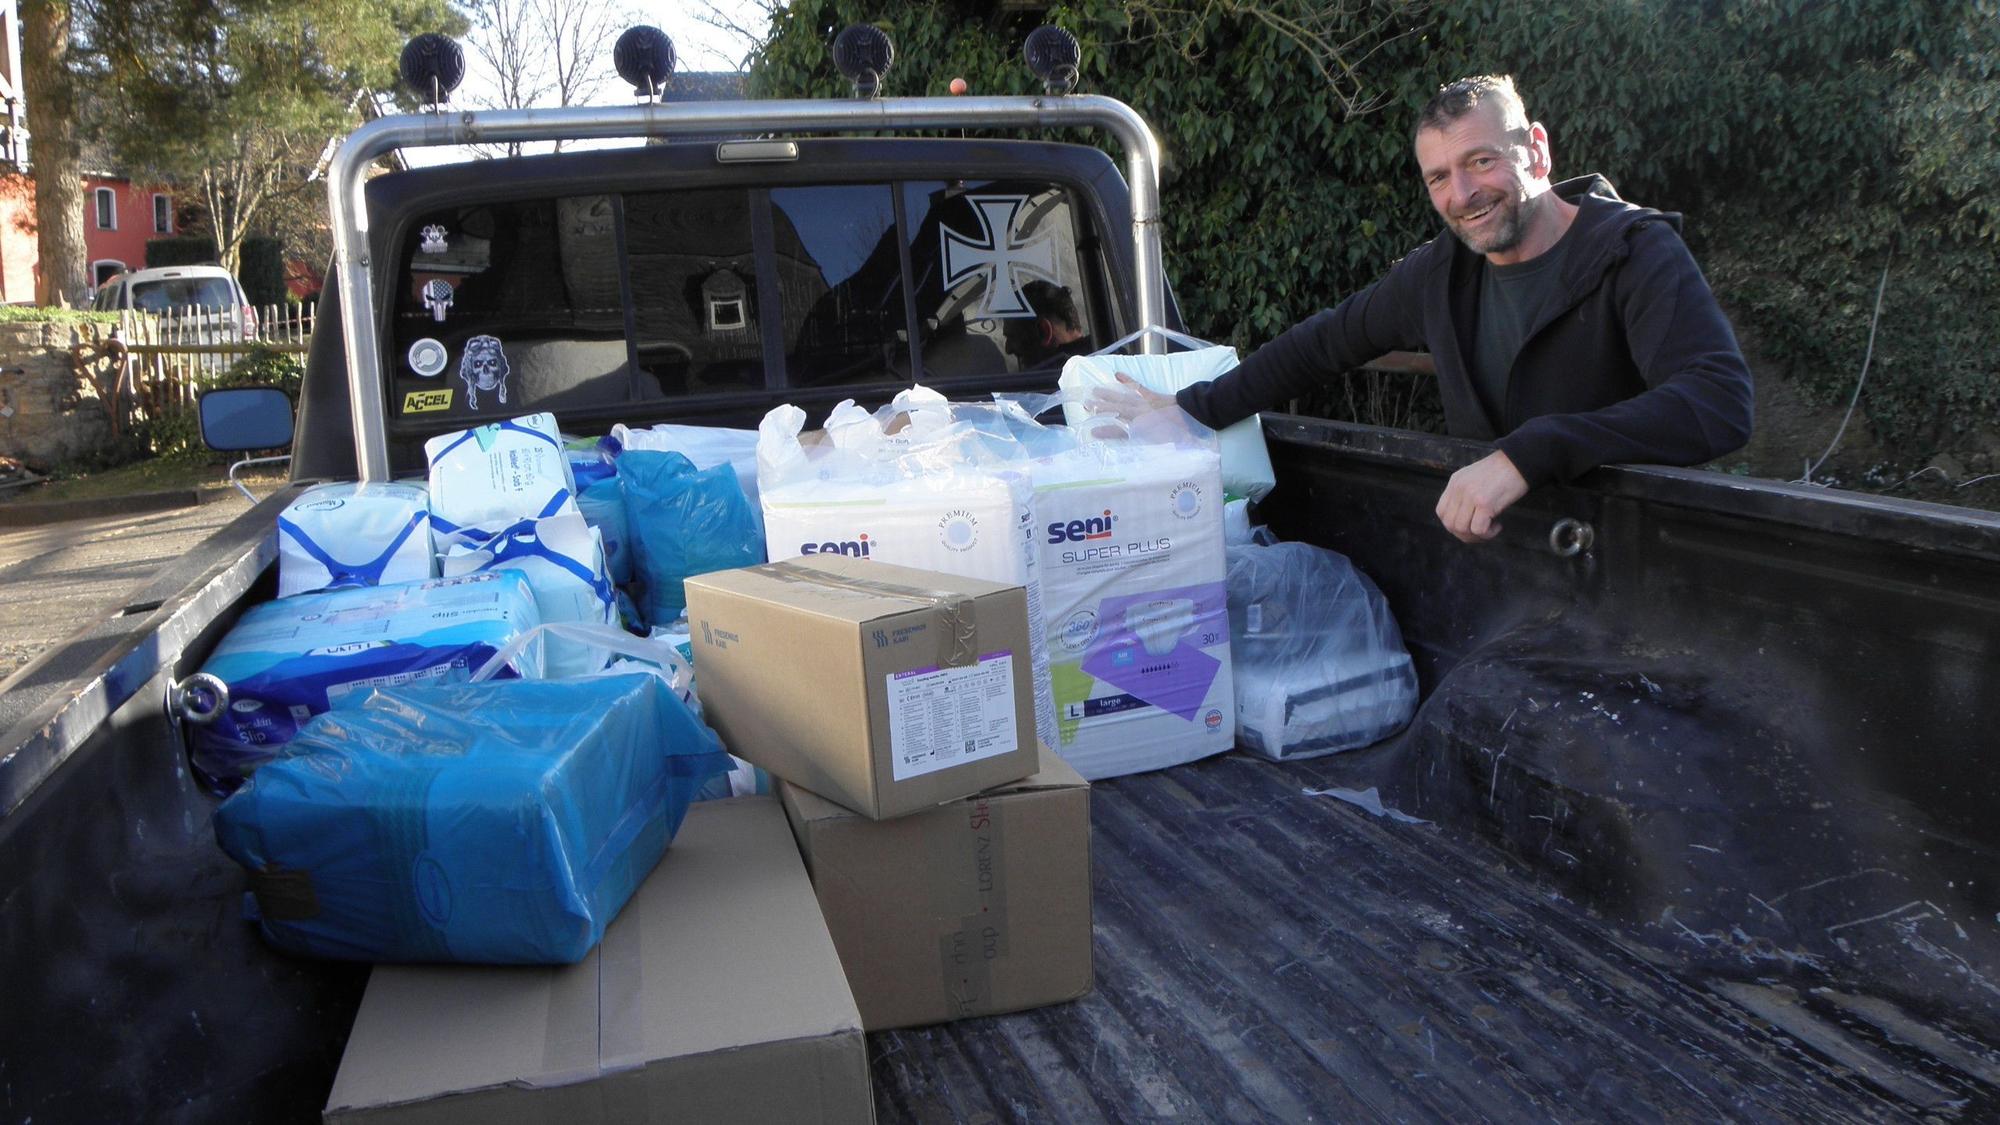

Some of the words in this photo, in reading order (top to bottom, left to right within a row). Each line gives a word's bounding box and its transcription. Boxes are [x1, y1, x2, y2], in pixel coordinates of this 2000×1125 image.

[406, 393, 448, 411] ACCEL
[938, 509, 978, 529] PREMIUM
[1047, 509, 1112, 544] seni
[800, 533, 870, 560] seni
[1062, 545, 1121, 564] SUPER
[1127, 537, 1171, 555] PLUS
[1202, 632, 1215, 645] 30
[1070, 705, 1080, 717] L
[1100, 697, 1121, 708] large
[239, 731, 266, 744] Slip
[977, 836, 993, 893] LORENZ
